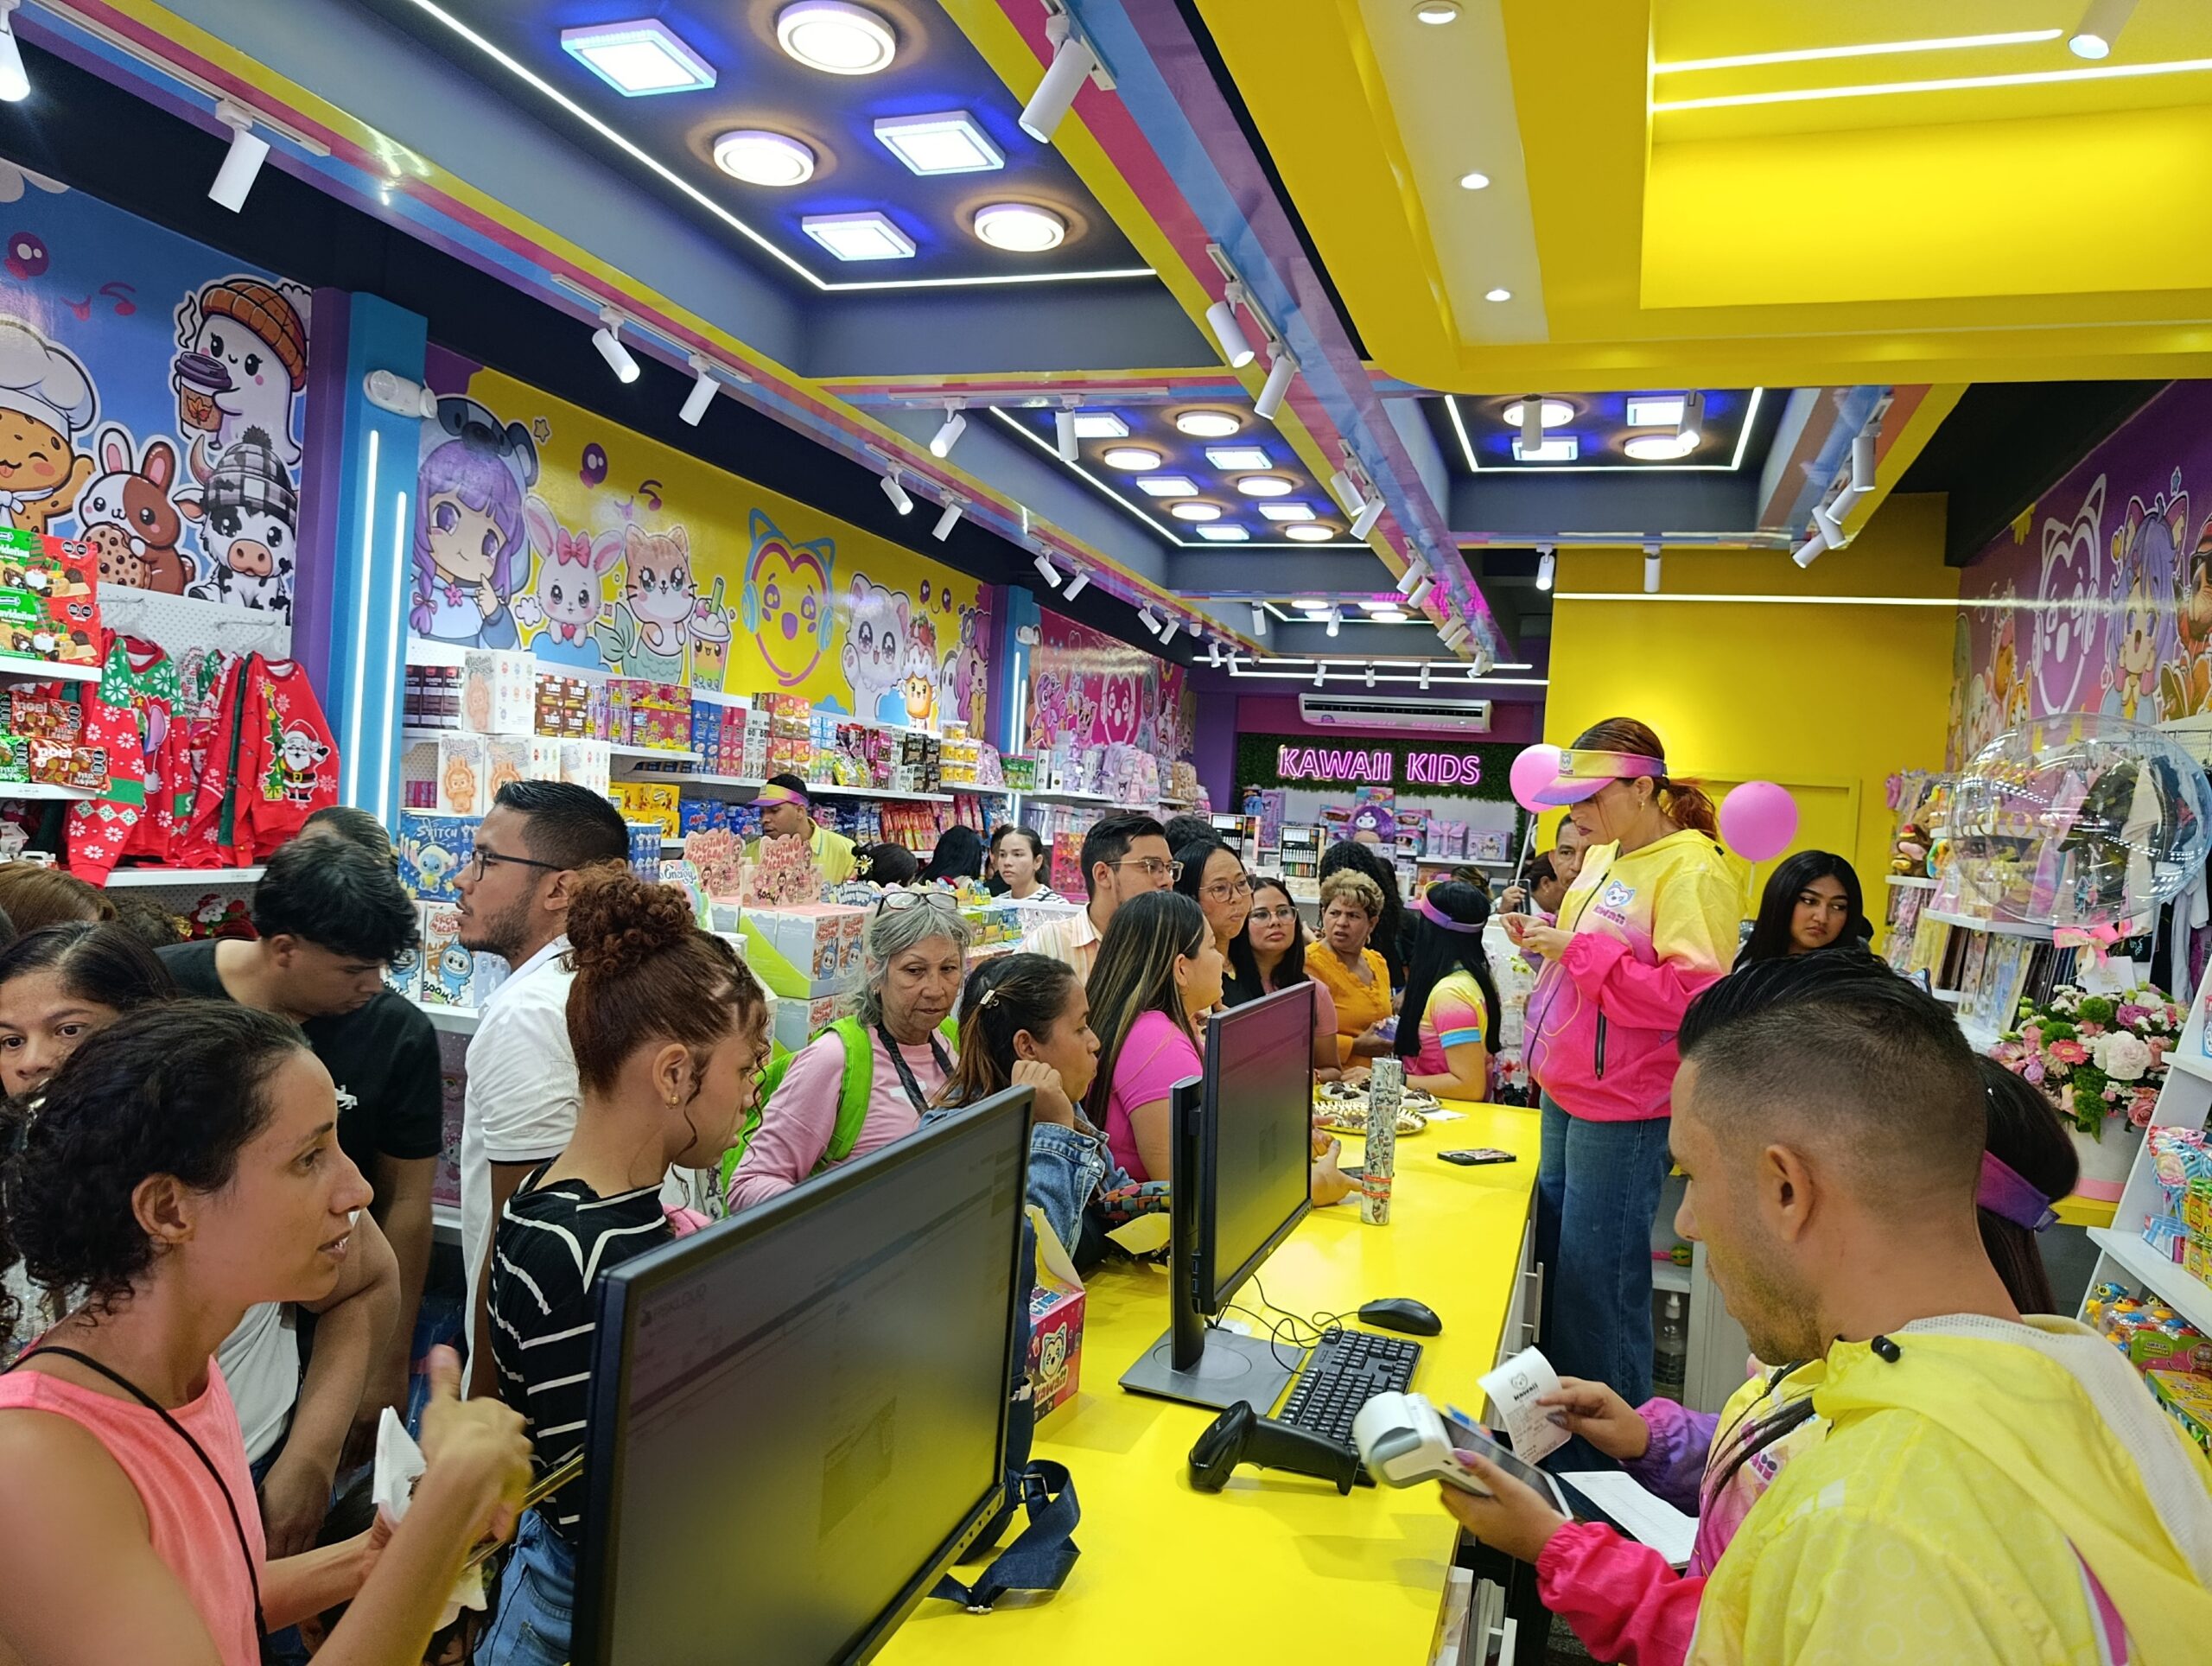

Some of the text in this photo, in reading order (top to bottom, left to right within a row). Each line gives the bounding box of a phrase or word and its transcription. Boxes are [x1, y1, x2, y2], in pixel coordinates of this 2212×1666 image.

[18, 702, 48, 713] noel
[38, 747, 72, 759] noel
[1279, 748, 1480, 785] KAWAII KIDS
[416, 825, 458, 838] STITCH
[691, 832, 729, 854] EXCITING
[766, 838, 800, 858] EXCITING
[423, 982, 454, 1004] BOOM!
